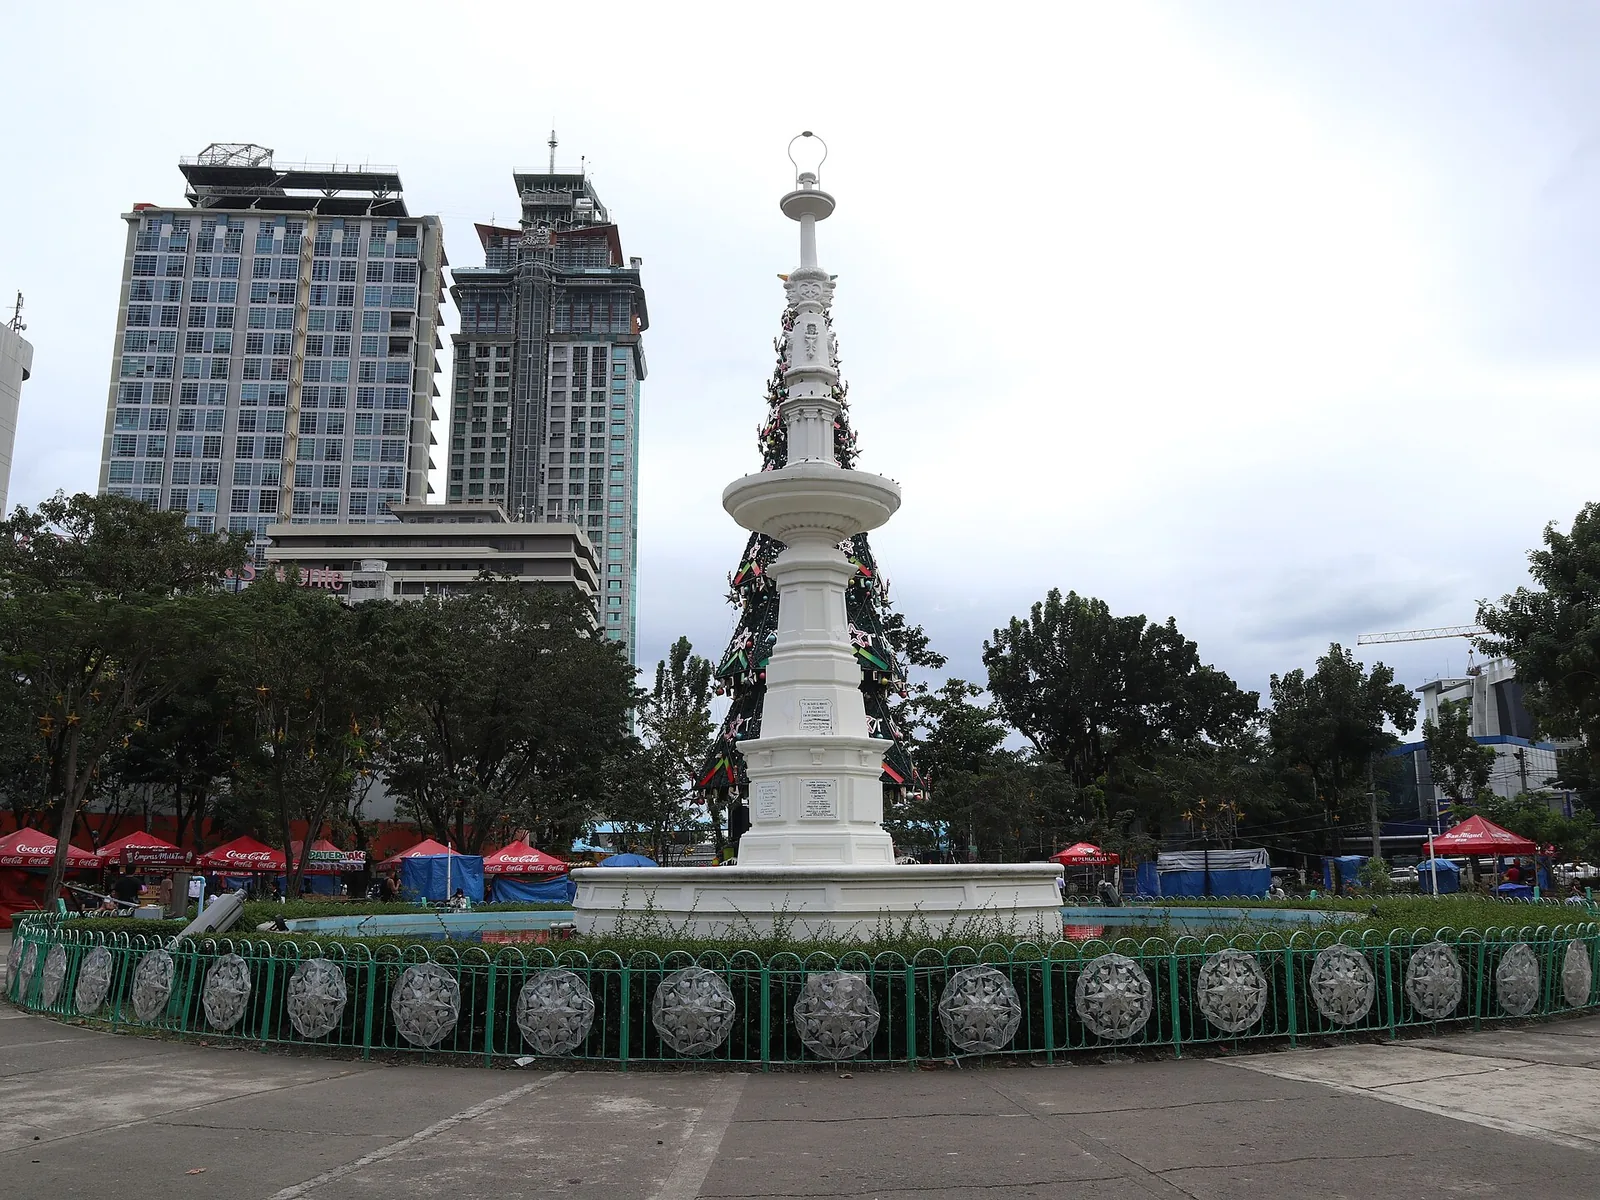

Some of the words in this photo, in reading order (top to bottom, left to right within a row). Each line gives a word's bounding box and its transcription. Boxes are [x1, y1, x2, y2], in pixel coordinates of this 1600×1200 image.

[134, 851, 157, 861] Empress
[225, 850, 271, 861] Coca-Cola
[500, 854, 539, 863] Coca-Cola
